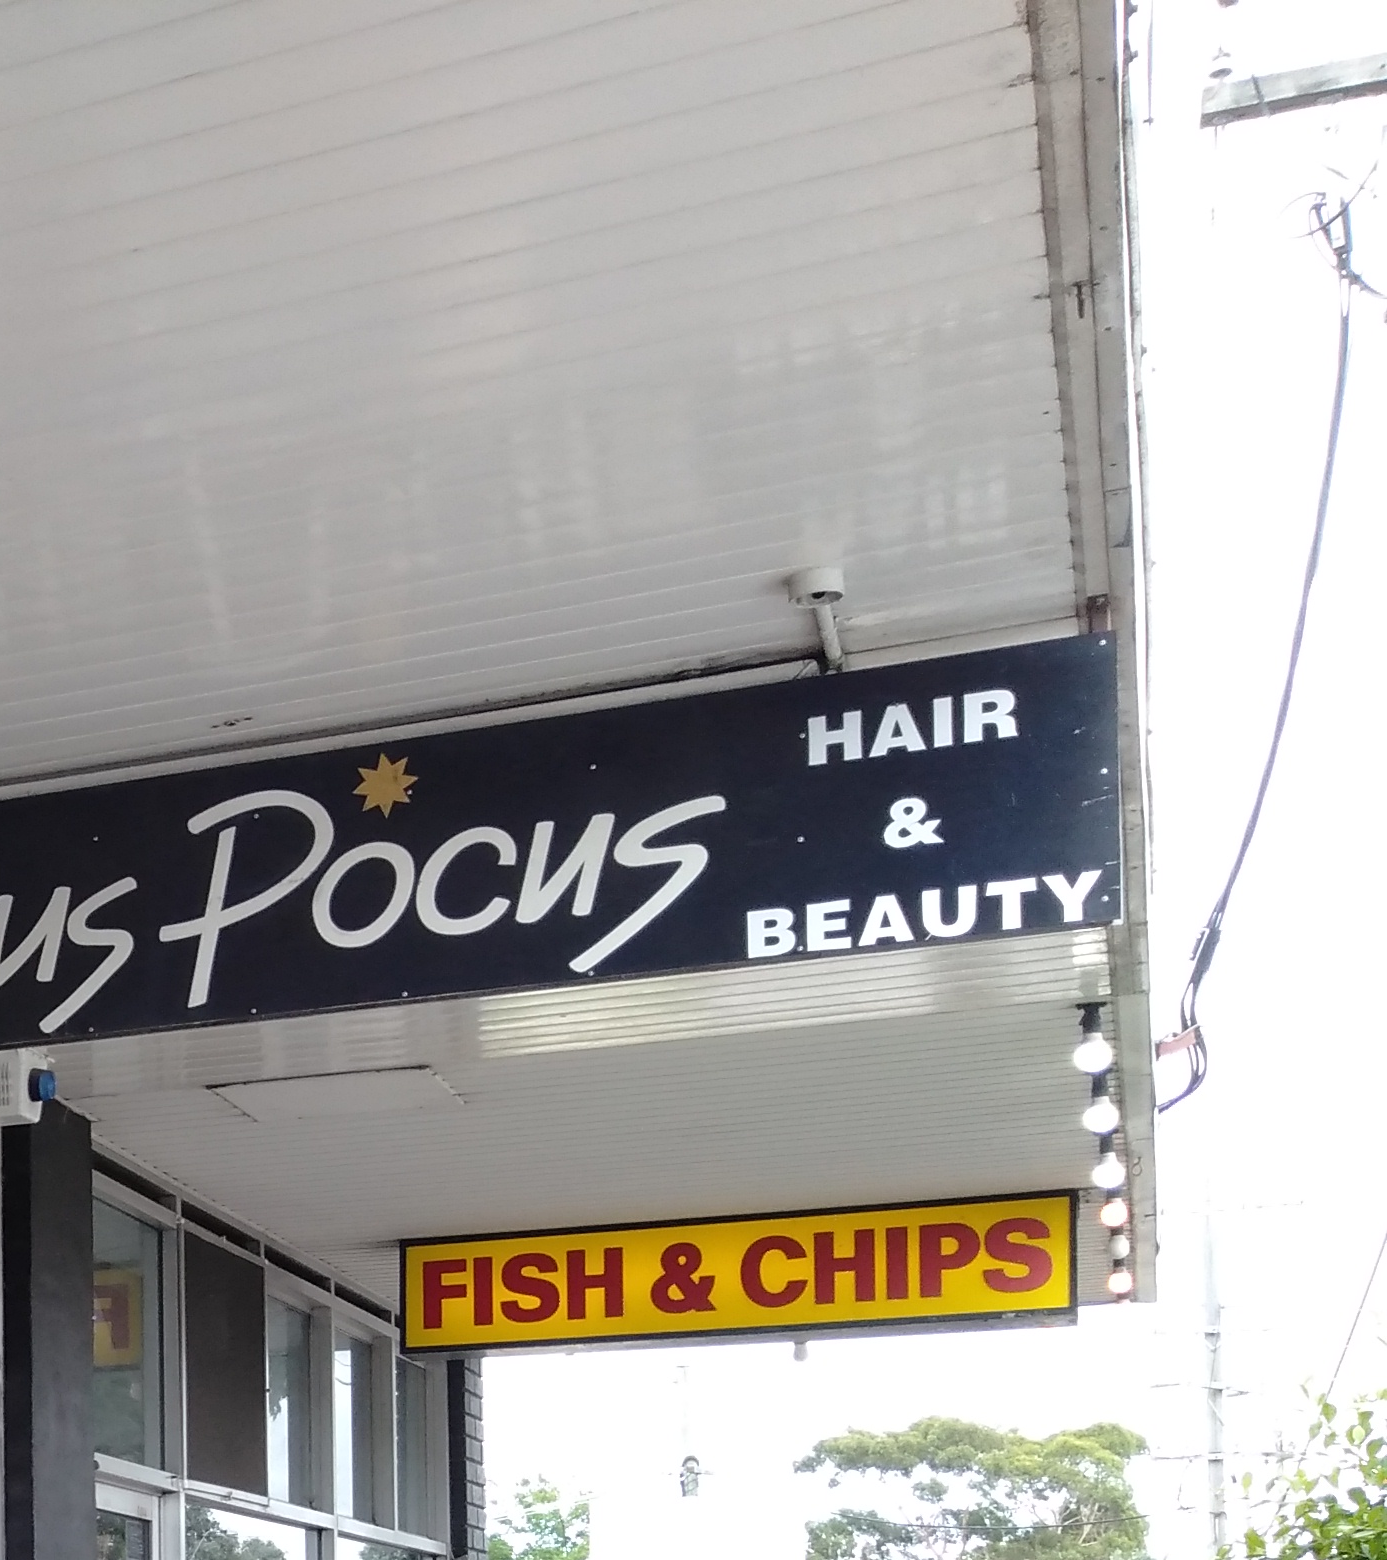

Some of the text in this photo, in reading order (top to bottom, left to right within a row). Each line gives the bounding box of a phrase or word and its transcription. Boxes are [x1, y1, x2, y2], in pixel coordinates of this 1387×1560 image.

[807, 689, 1019, 766] HAIR
[883, 797, 945, 849] &
[746, 869, 1103, 959] BEAUTY
[422, 1216, 1054, 1330] FISH & CHIPS
